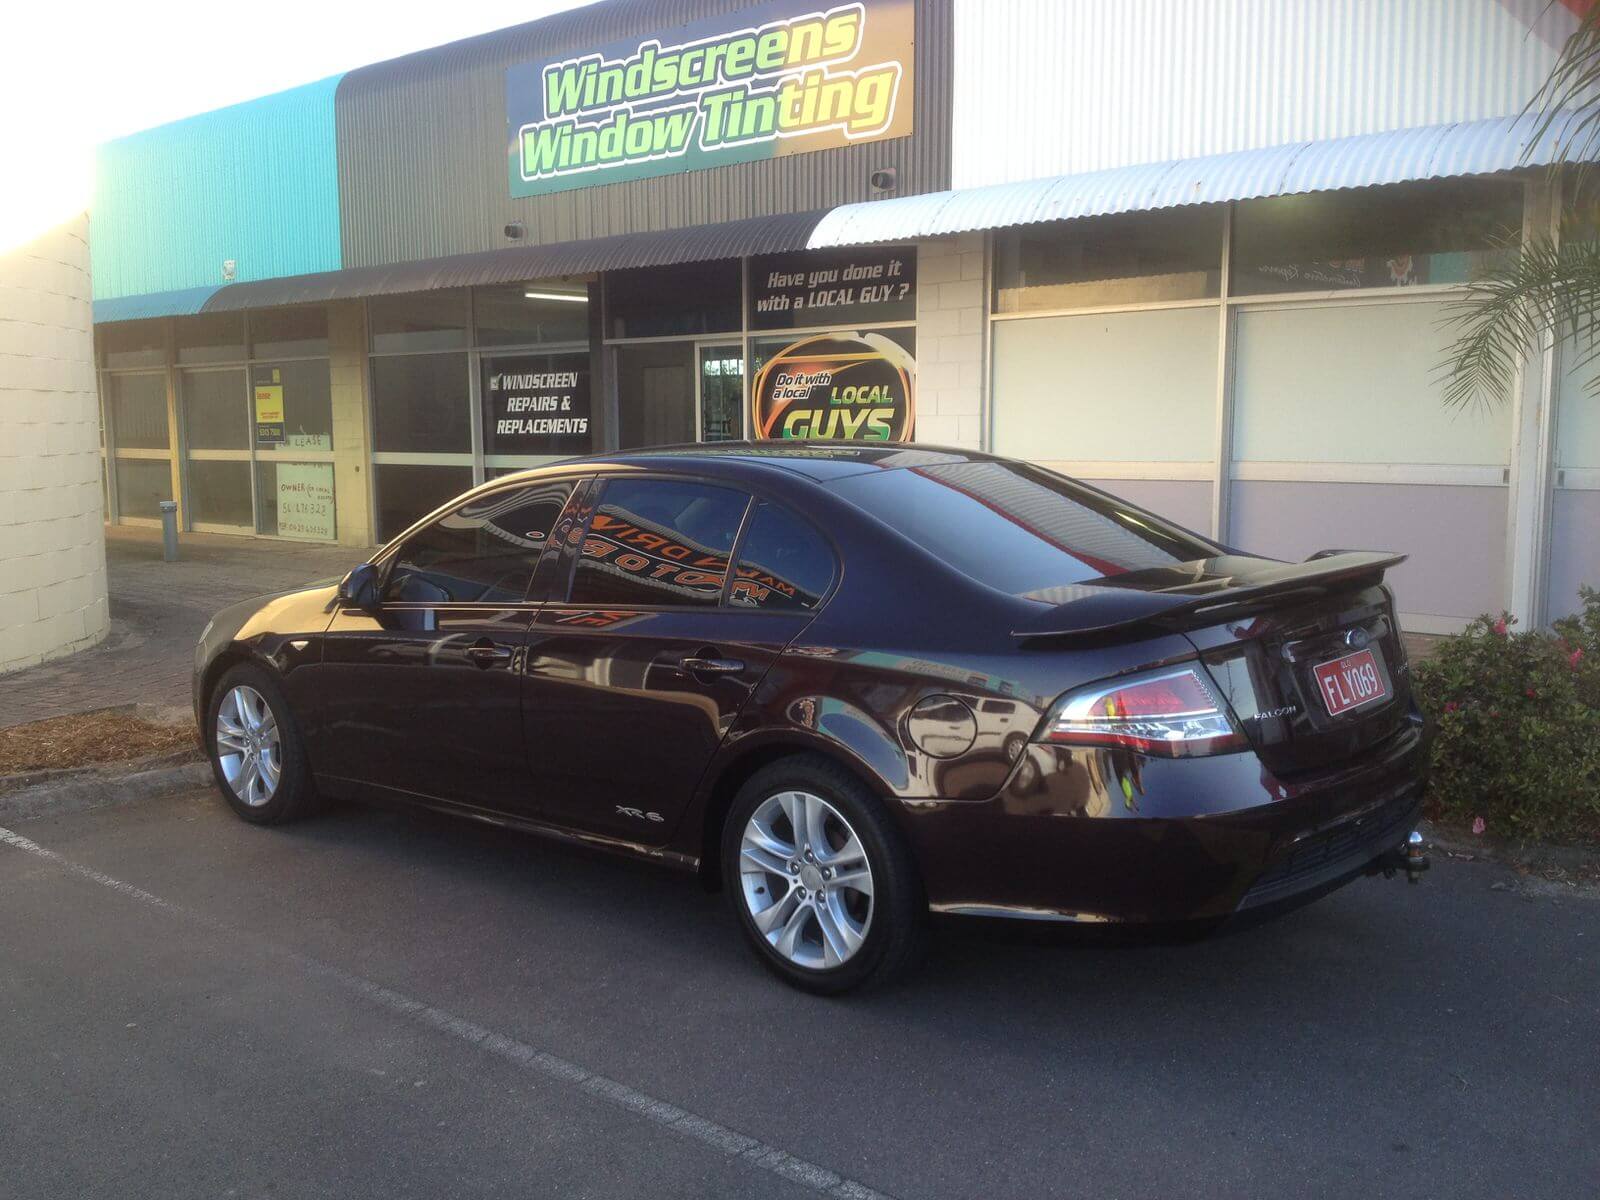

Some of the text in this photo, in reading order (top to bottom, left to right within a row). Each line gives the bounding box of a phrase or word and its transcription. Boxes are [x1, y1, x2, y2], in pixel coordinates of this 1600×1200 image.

[545, 8, 862, 117] Windscreens
[521, 65, 898, 178] Window Tinting
[767, 260, 902, 288] Have you done it
[757, 296, 789, 312] with
[794, 299, 803, 310] a
[808, 288, 854, 308] LOCAL
[859, 284, 894, 304] GUY
[503, 372, 579, 391] WINDSCREEN
[776, 371, 832, 387] Do it with
[772, 385, 811, 400] a local
[830, 385, 894, 405] LOCAL
[507, 395, 571, 412] REPAIRS &
[497, 418, 588, 435] REPLACEMENTS
[782, 407, 896, 441] GUYS
[295, 435, 321, 447] LEASE
[281, 482, 305, 493] OWNER
[1323, 662, 1378, 709] FLY069
[1254, 705, 1297, 720] FALCON
